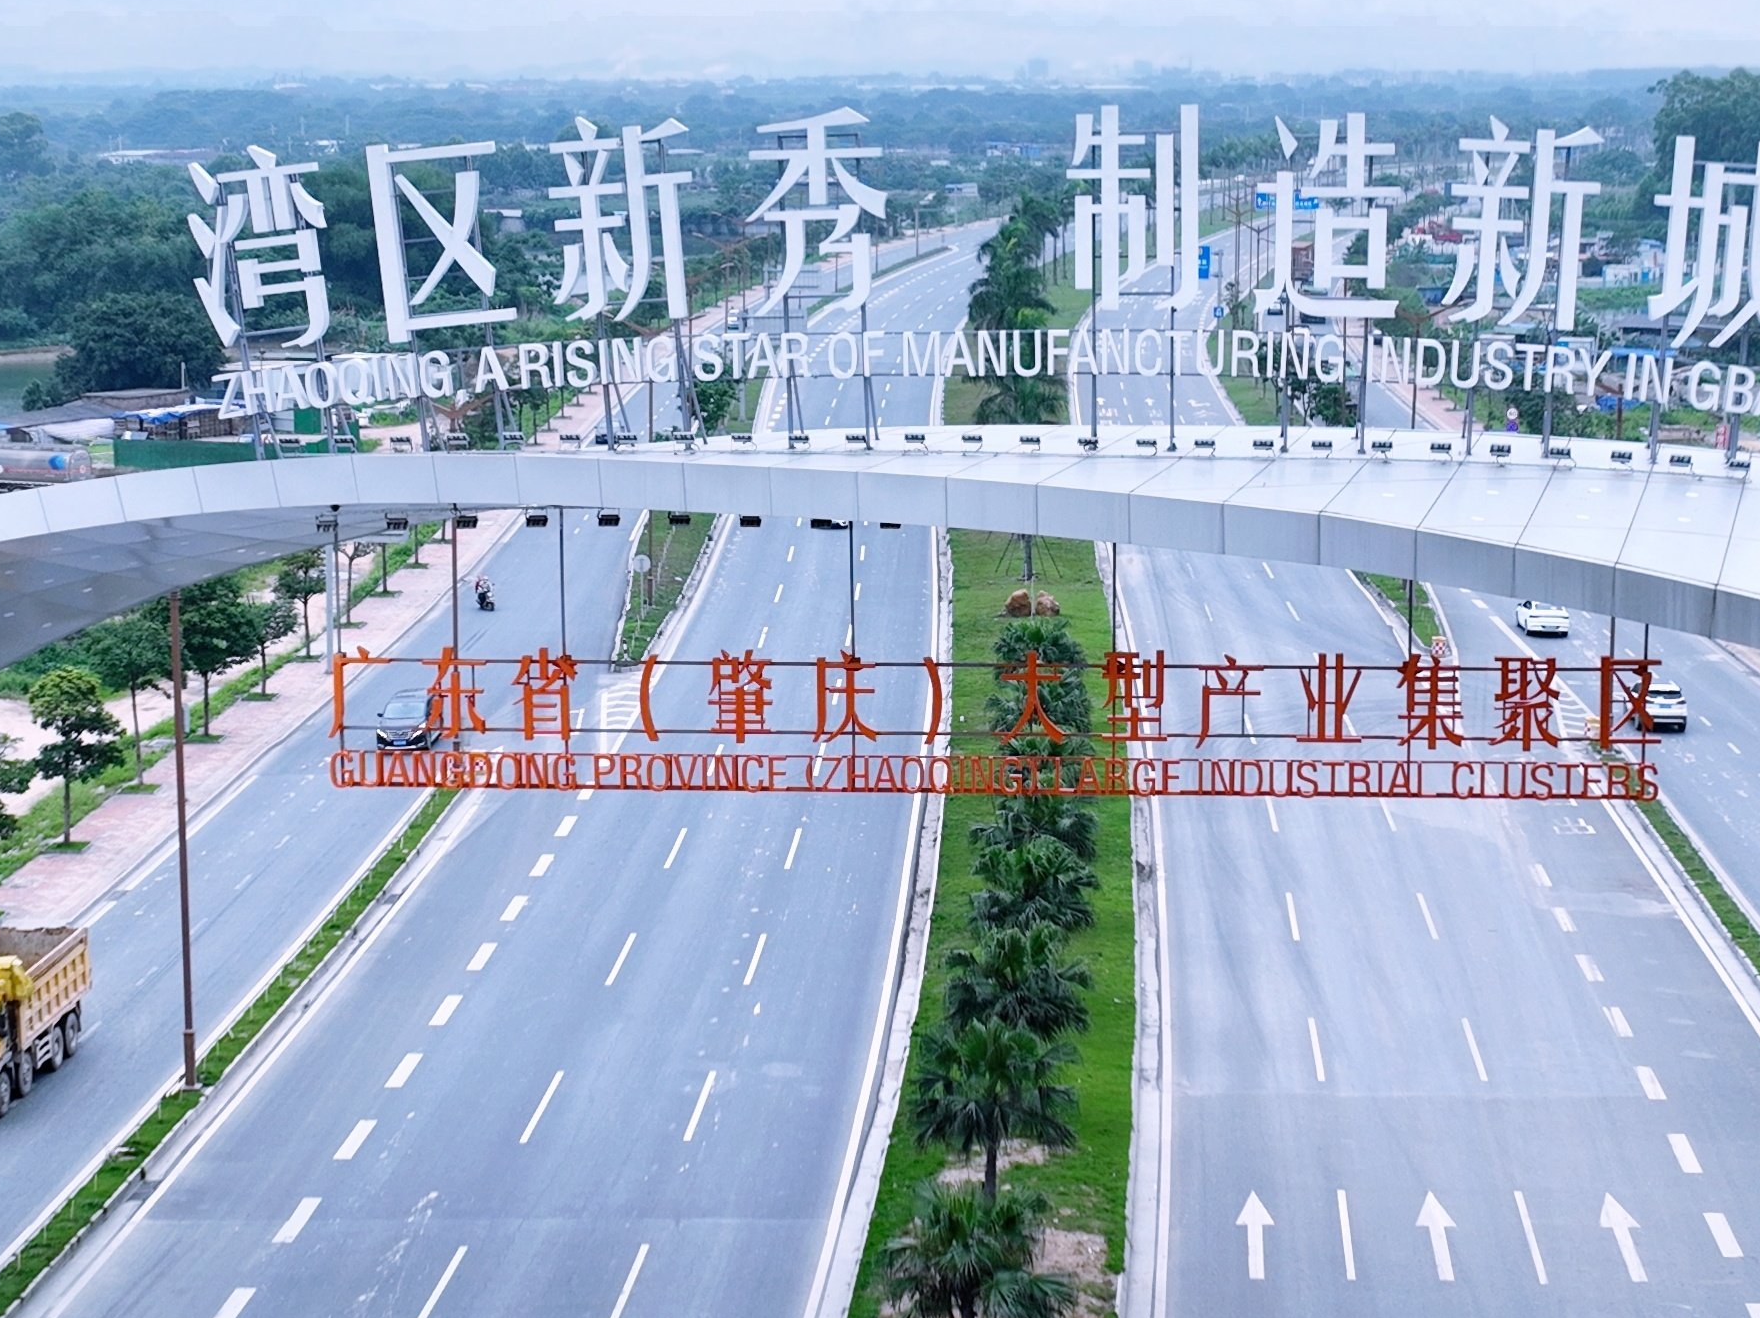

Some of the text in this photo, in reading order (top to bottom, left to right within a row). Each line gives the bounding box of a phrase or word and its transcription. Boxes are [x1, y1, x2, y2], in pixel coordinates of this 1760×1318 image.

[188, 106, 888, 348] 湾区新秀
[211, 348, 454, 421] ZHAOQING
[475, 345, 510, 394] A
[518, 333, 679, 390] RISING
[693, 331, 809, 382] STAR
[827, 330, 886, 380] OF
[903, 327, 1347, 385] MANUFANCTURING
[1367, 336, 1612, 396] INDUSTRY
[1625, 352, 1675, 405] IN
[329, 750, 578, 792] GUANGDONG
[593, 752, 788, 793] PROVINCE
[1051, 758, 1181, 797] LARGE
[1198, 758, 1438, 799] INDUSTRIAL
[1452, 761, 1660, 802] CLUSTERS
